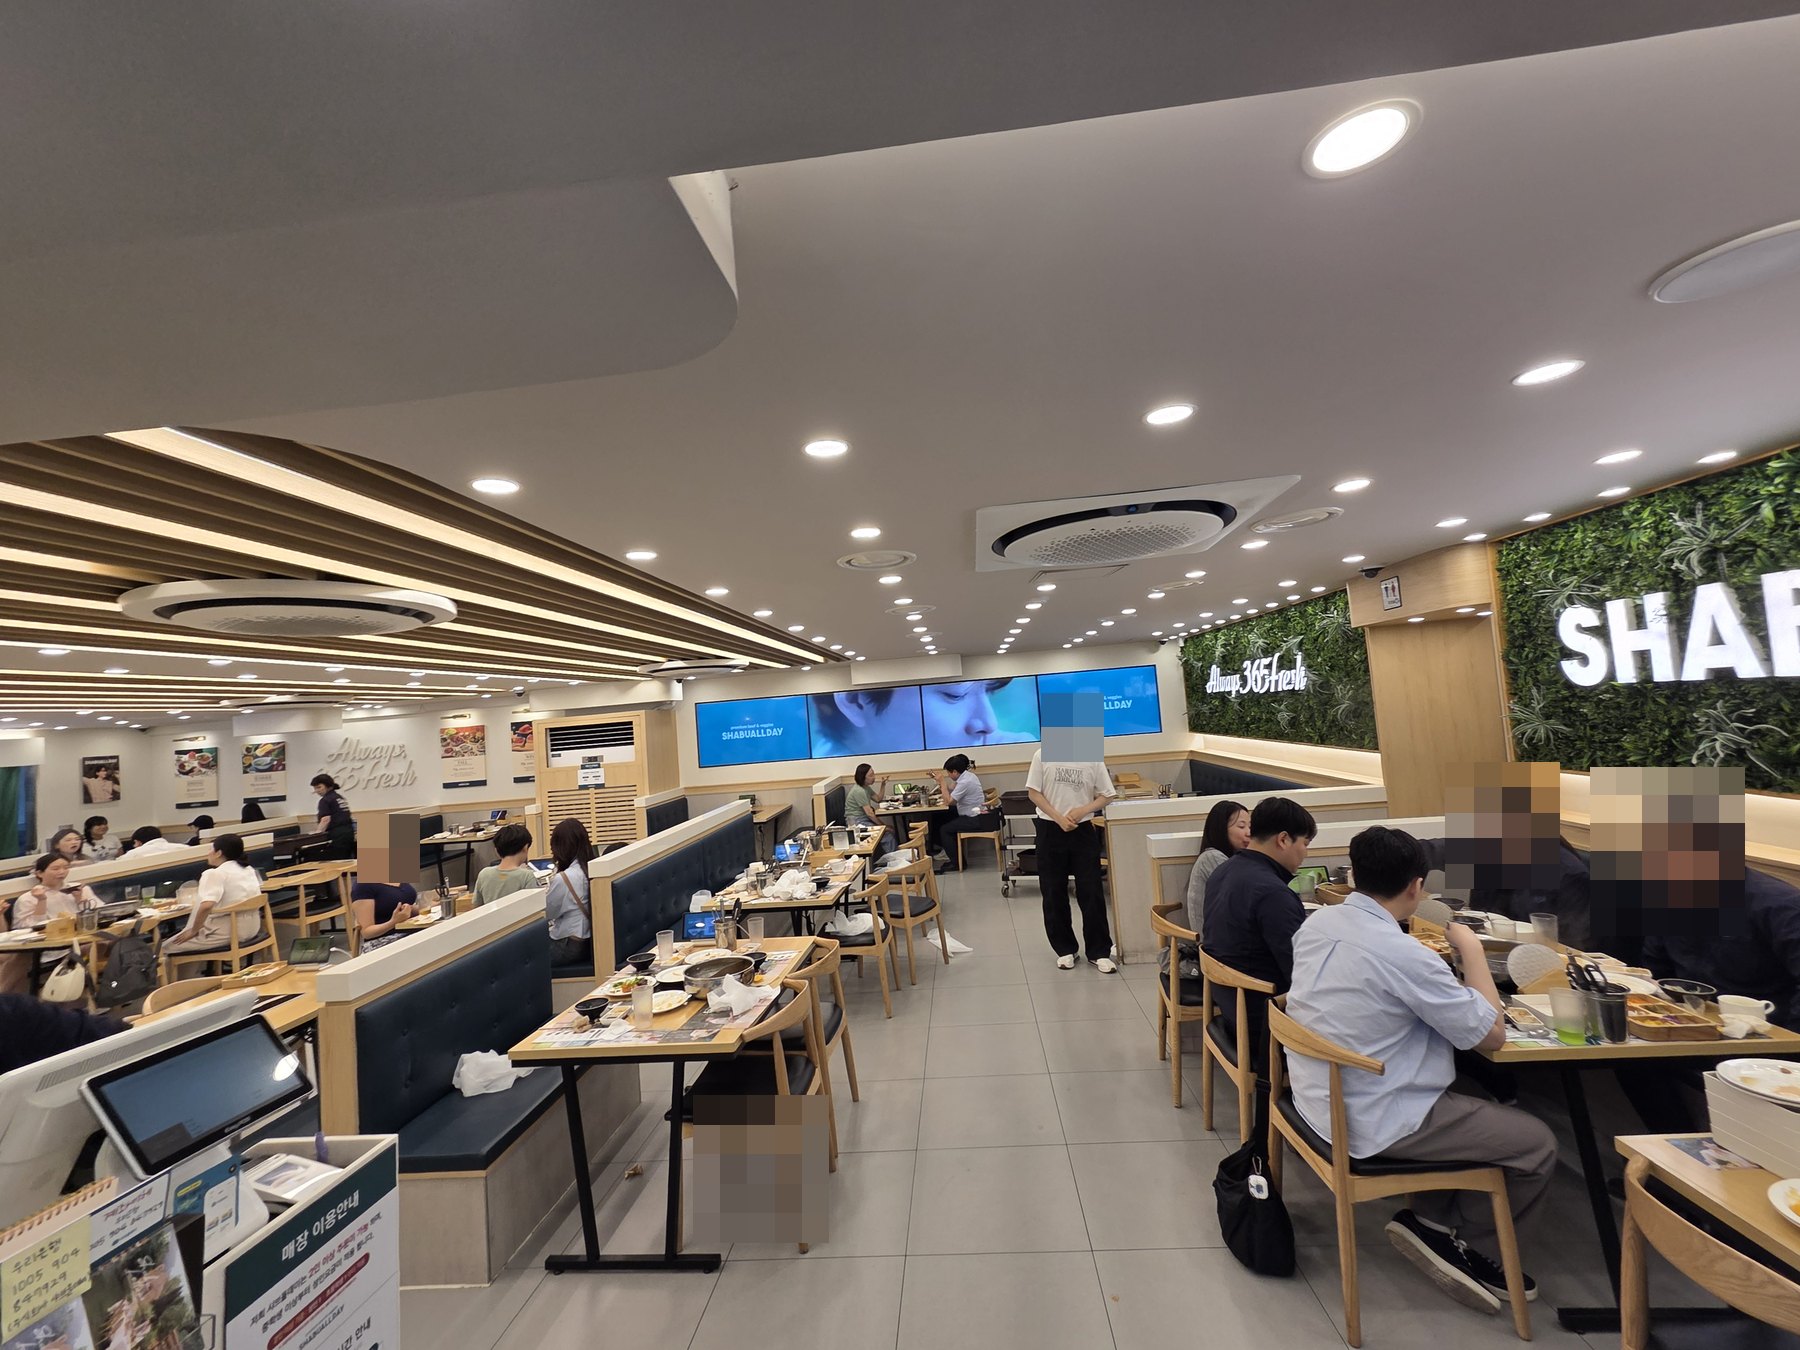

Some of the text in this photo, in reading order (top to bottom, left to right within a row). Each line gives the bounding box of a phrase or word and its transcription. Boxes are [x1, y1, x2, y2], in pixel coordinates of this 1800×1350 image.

[1206, 664, 1240, 697] Always
[1103, 699, 1132, 710] LLDAY
[722, 728, 783, 740] SHABUALLDAY
[281, 1189, 360, 1261] 매장 이용안내
[12, 1238, 62, 1273] 우리은행
[13, 1247, 80, 1295] 1005 904
[355, 1316, 371, 1340] 안내
